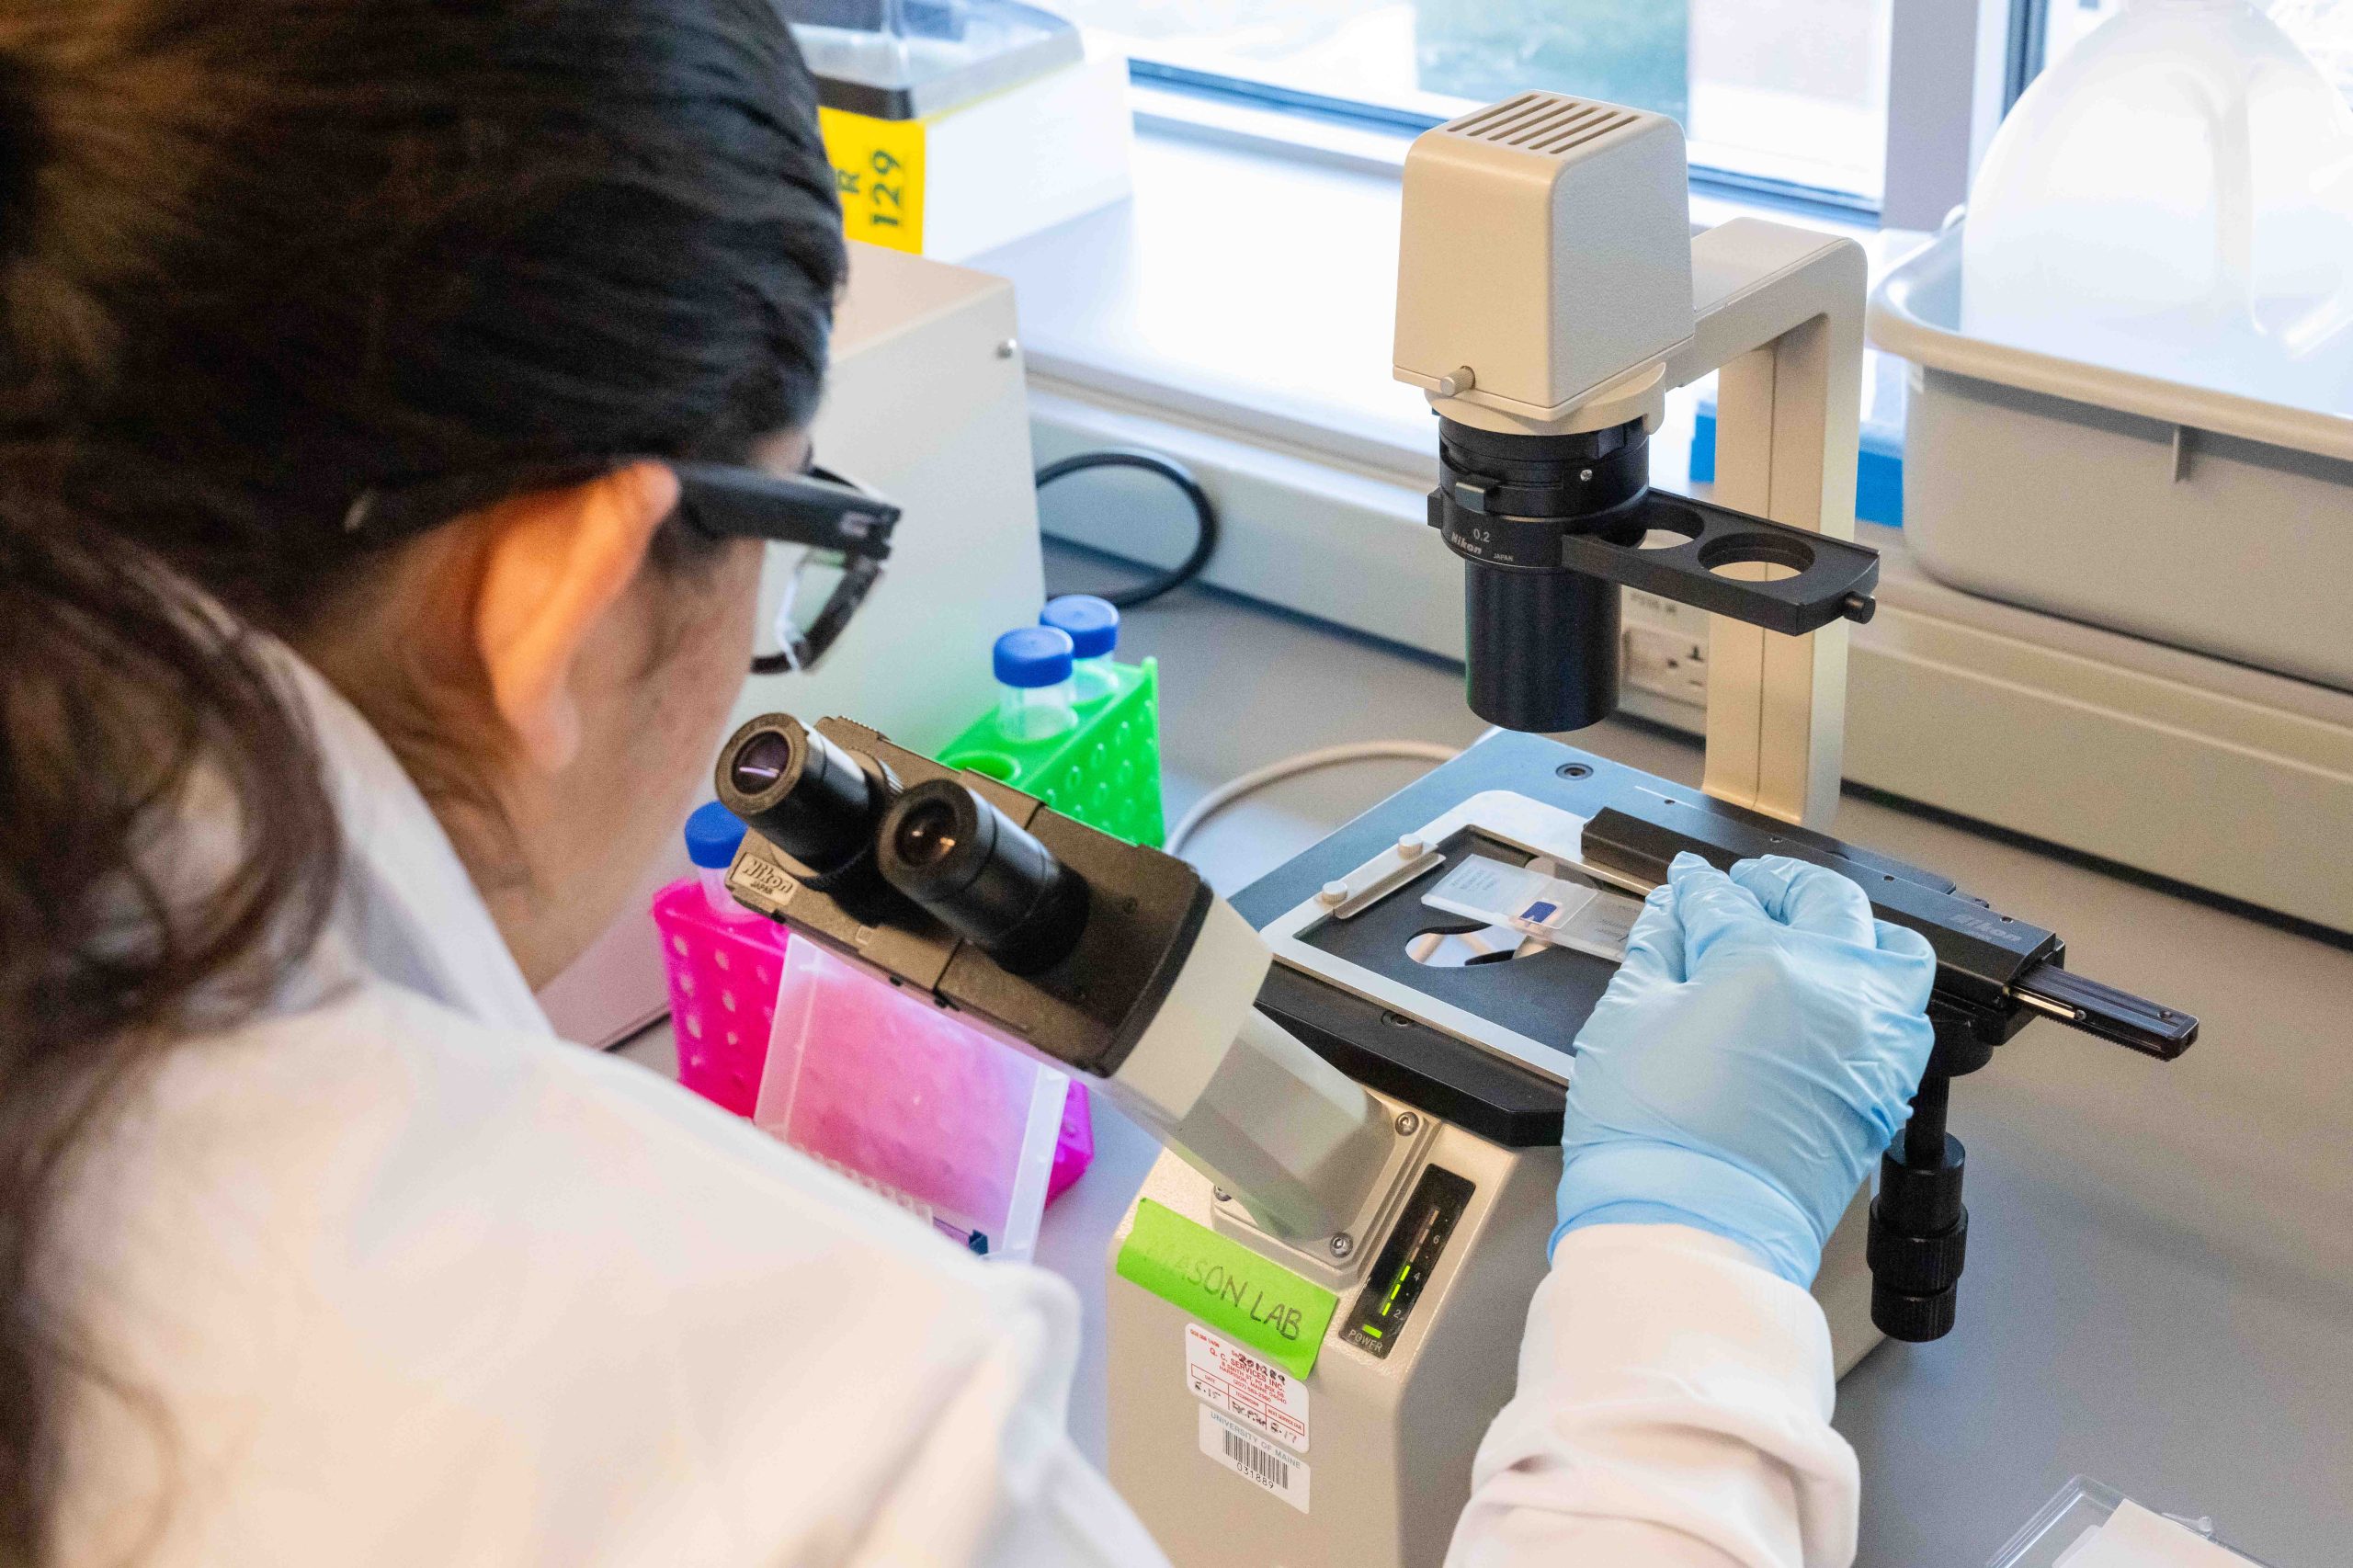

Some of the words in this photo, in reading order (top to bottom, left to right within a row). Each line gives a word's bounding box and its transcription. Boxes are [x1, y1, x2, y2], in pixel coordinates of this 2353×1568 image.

[872, 150, 901, 225] 129
[1451, 531, 1483, 555] Nikon
[1473, 528, 1490, 542] 0.2
[1494, 553, 1514, 562] JAPAN
[743, 860, 794, 893] Nikon
[1433, 1234, 1441, 1244] 6
[1414, 1272, 1421, 1282] 4
[1250, 1290, 1302, 1340] LAB
[1392, 1309, 1401, 1319] 2
[1348, 1330, 1384, 1353] POWER
[1227, 1364, 1245, 1376] SMITH
[1230, 1358, 1267, 1381] SERVICES
[1269, 1379, 1285, 1392] INC.
[1250, 1381, 1267, 1394] MAINE
[1211, 1411, 1259, 1444] UNIVERSITY
[1261, 1439, 1273, 1451] OF
[1275, 1448, 1302, 1470] MAINE
[1236, 1462, 1275, 1490] 031889
